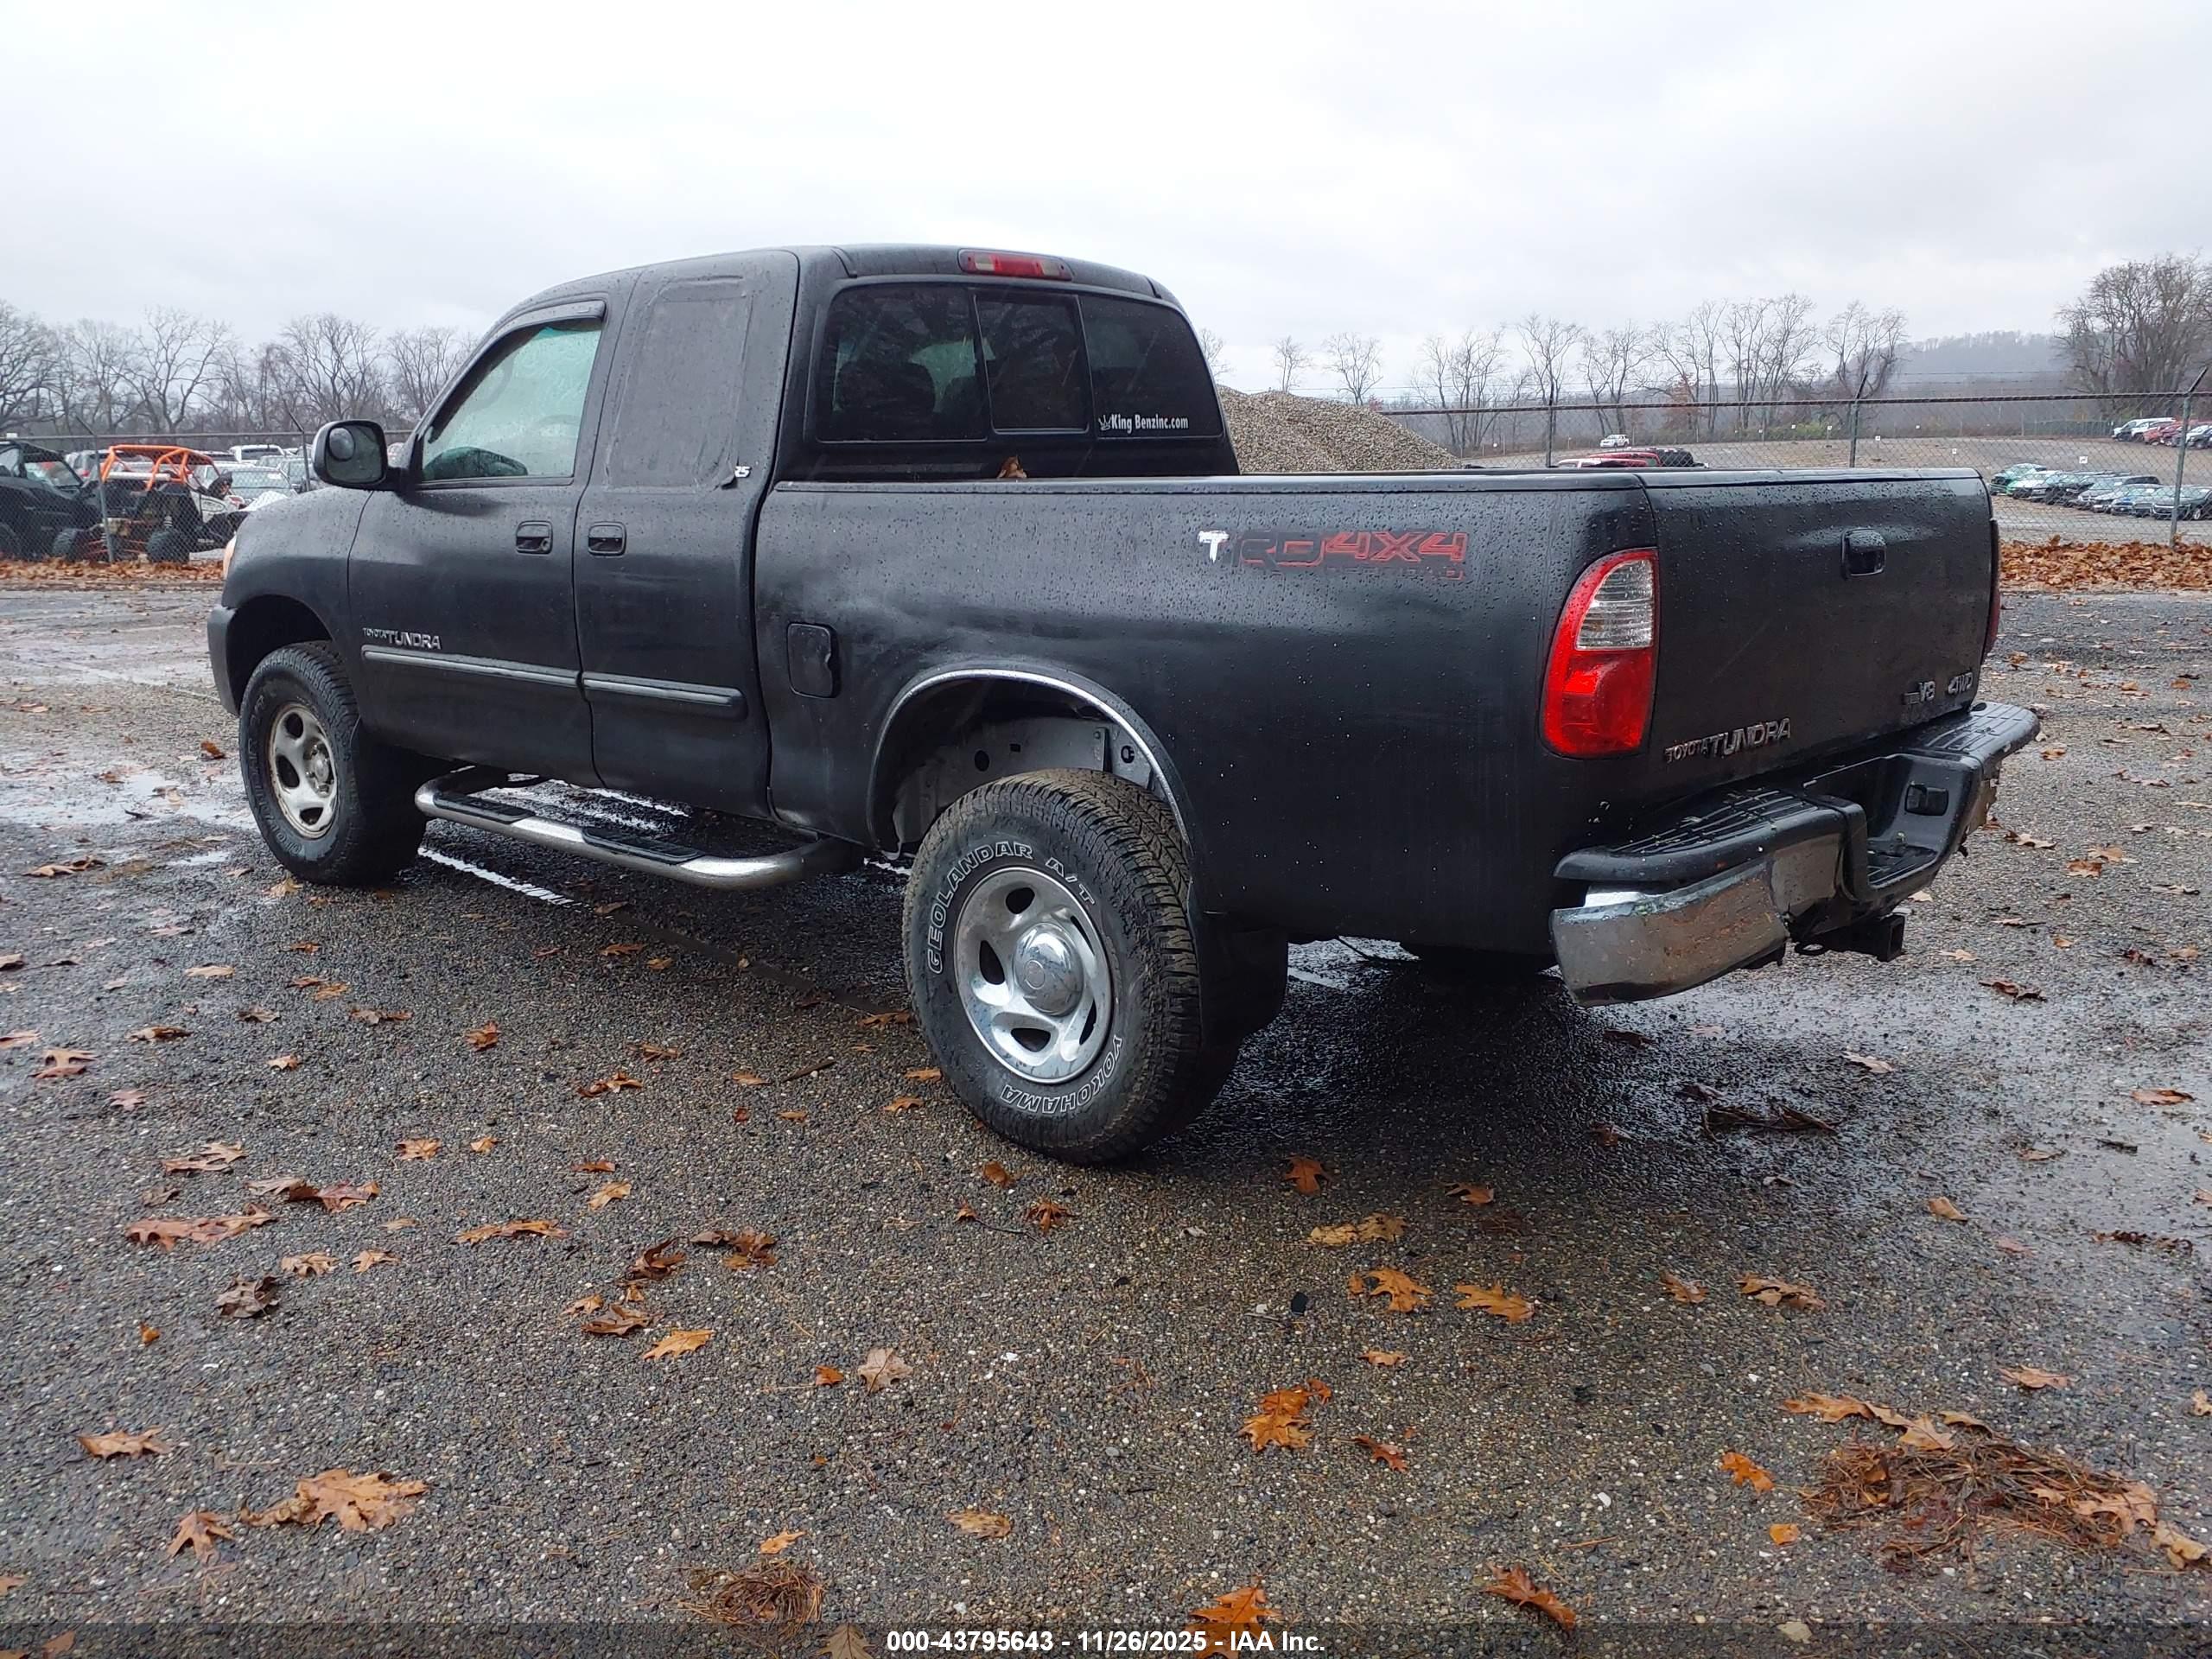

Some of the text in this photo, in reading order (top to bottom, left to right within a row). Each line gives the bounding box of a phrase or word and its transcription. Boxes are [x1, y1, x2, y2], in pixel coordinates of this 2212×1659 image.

[1112, 414, 1132, 434] King
[363, 627, 442, 650] TOYOTA TUNDRA
[1918, 680, 1936, 702] V8
[1664, 717, 1791, 763] TOYOTA TUNDRA
[927, 840, 1095, 974] GEOLANDAR A/T
[1000, 1033, 1122, 1114] YOKOHAMA
